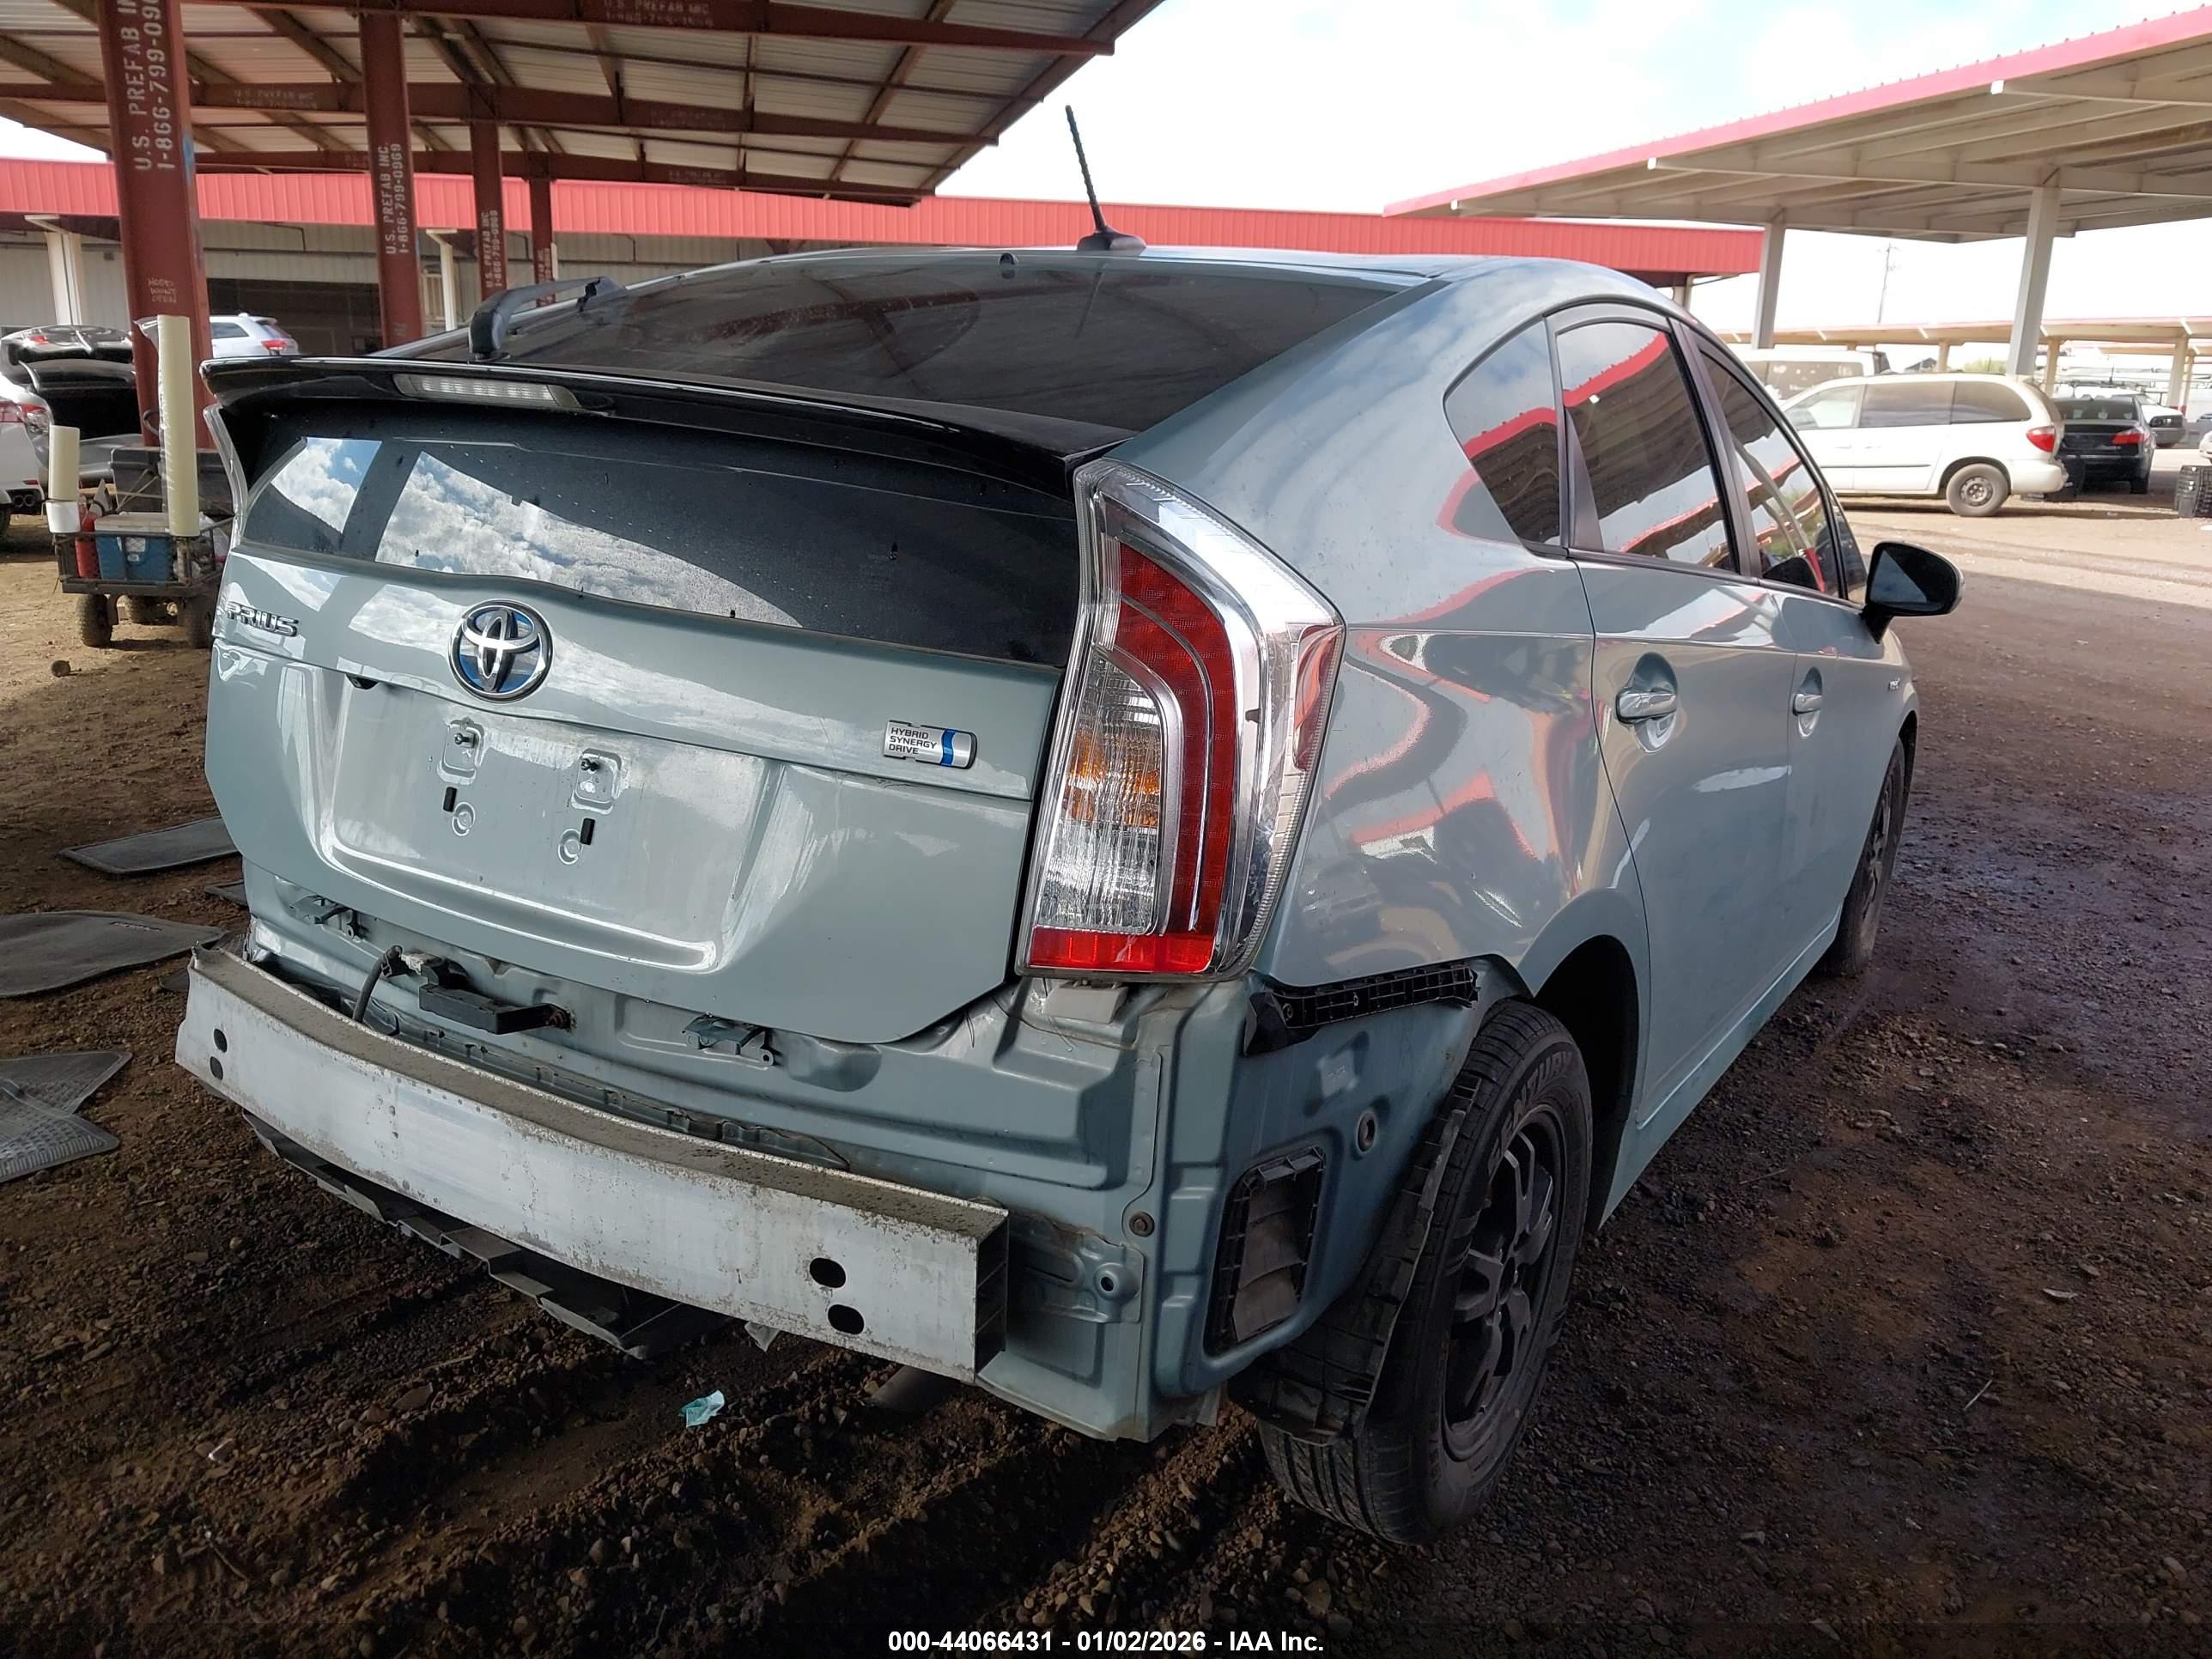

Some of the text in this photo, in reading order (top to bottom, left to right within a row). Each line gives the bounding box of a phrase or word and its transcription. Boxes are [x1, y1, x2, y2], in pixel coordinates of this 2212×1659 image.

[120, 27, 148, 116] PREFAB
[142, 0, 175, 170] 1-866-799-09
[132, 129, 153, 170] U.S.
[380, 173, 394, 223] PREFAB
[390, 143, 409, 253] 1-866-799-0969
[385, 230, 397, 254] U.S.
[224, 601, 299, 636] PRIUS
[889, 744, 919, 755] DRIVE
[890, 727, 929, 739] HYBRID
[890, 735, 937, 749] SYNERGY
